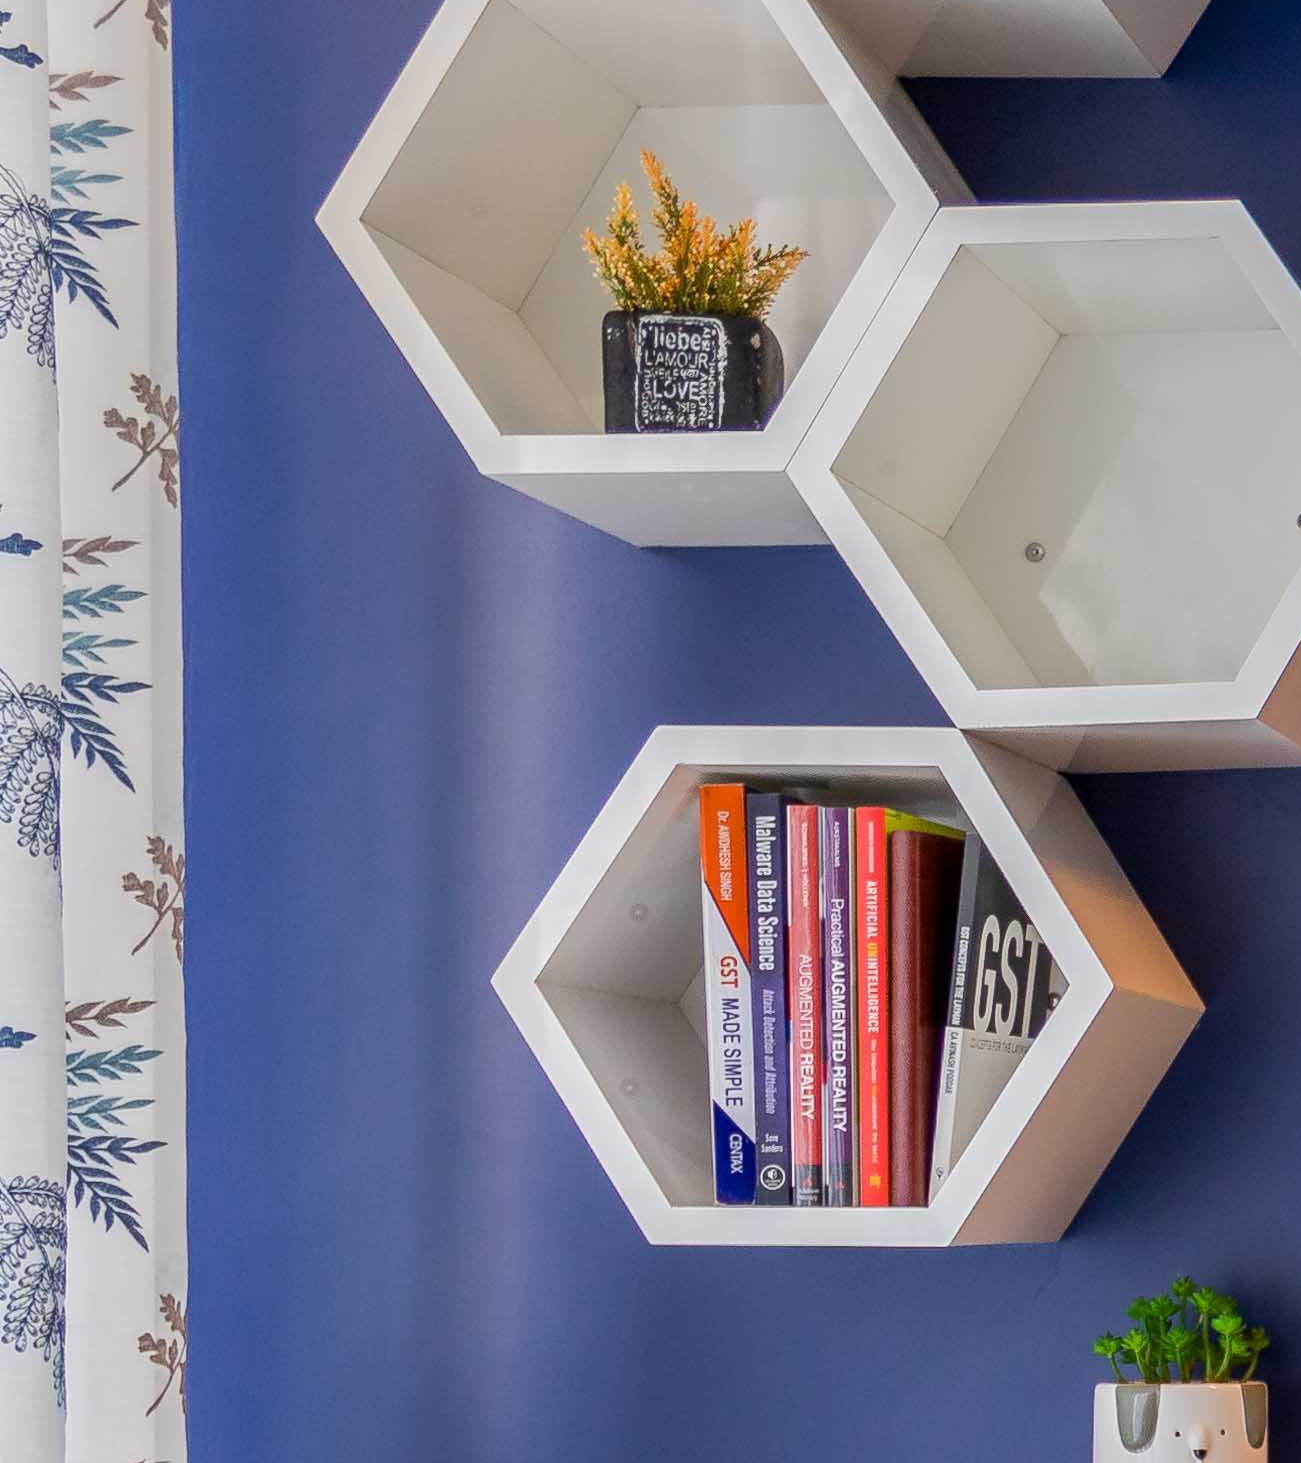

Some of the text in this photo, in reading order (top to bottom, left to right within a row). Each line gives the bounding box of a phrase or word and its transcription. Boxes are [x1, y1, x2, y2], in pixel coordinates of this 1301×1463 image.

[653, 326, 701, 351] liebe
[653, 377, 701, 400] LOVE
[719, 871, 733, 901] SINGH
[755, 815, 779, 971] Malware Data Science
[865, 880, 879, 939] ARTIFICIAL
[956, 940, 970, 973] CONCEPTS
[959, 926, 970, 940] GST
[866, 942, 880, 1033] UNINTELLIGENCE
[973, 914, 1044, 1039] GST
[720, 955, 743, 1107] GST MADE SIMPLE
[762, 989, 777, 1114] Attack Detection and Attribution
[799, 954, 815, 1121] AUGMENTED REALITY
[830, 898, 848, 1132] Practical AUGMENTED REALITY
[729, 1133, 743, 1175] CENTAX
